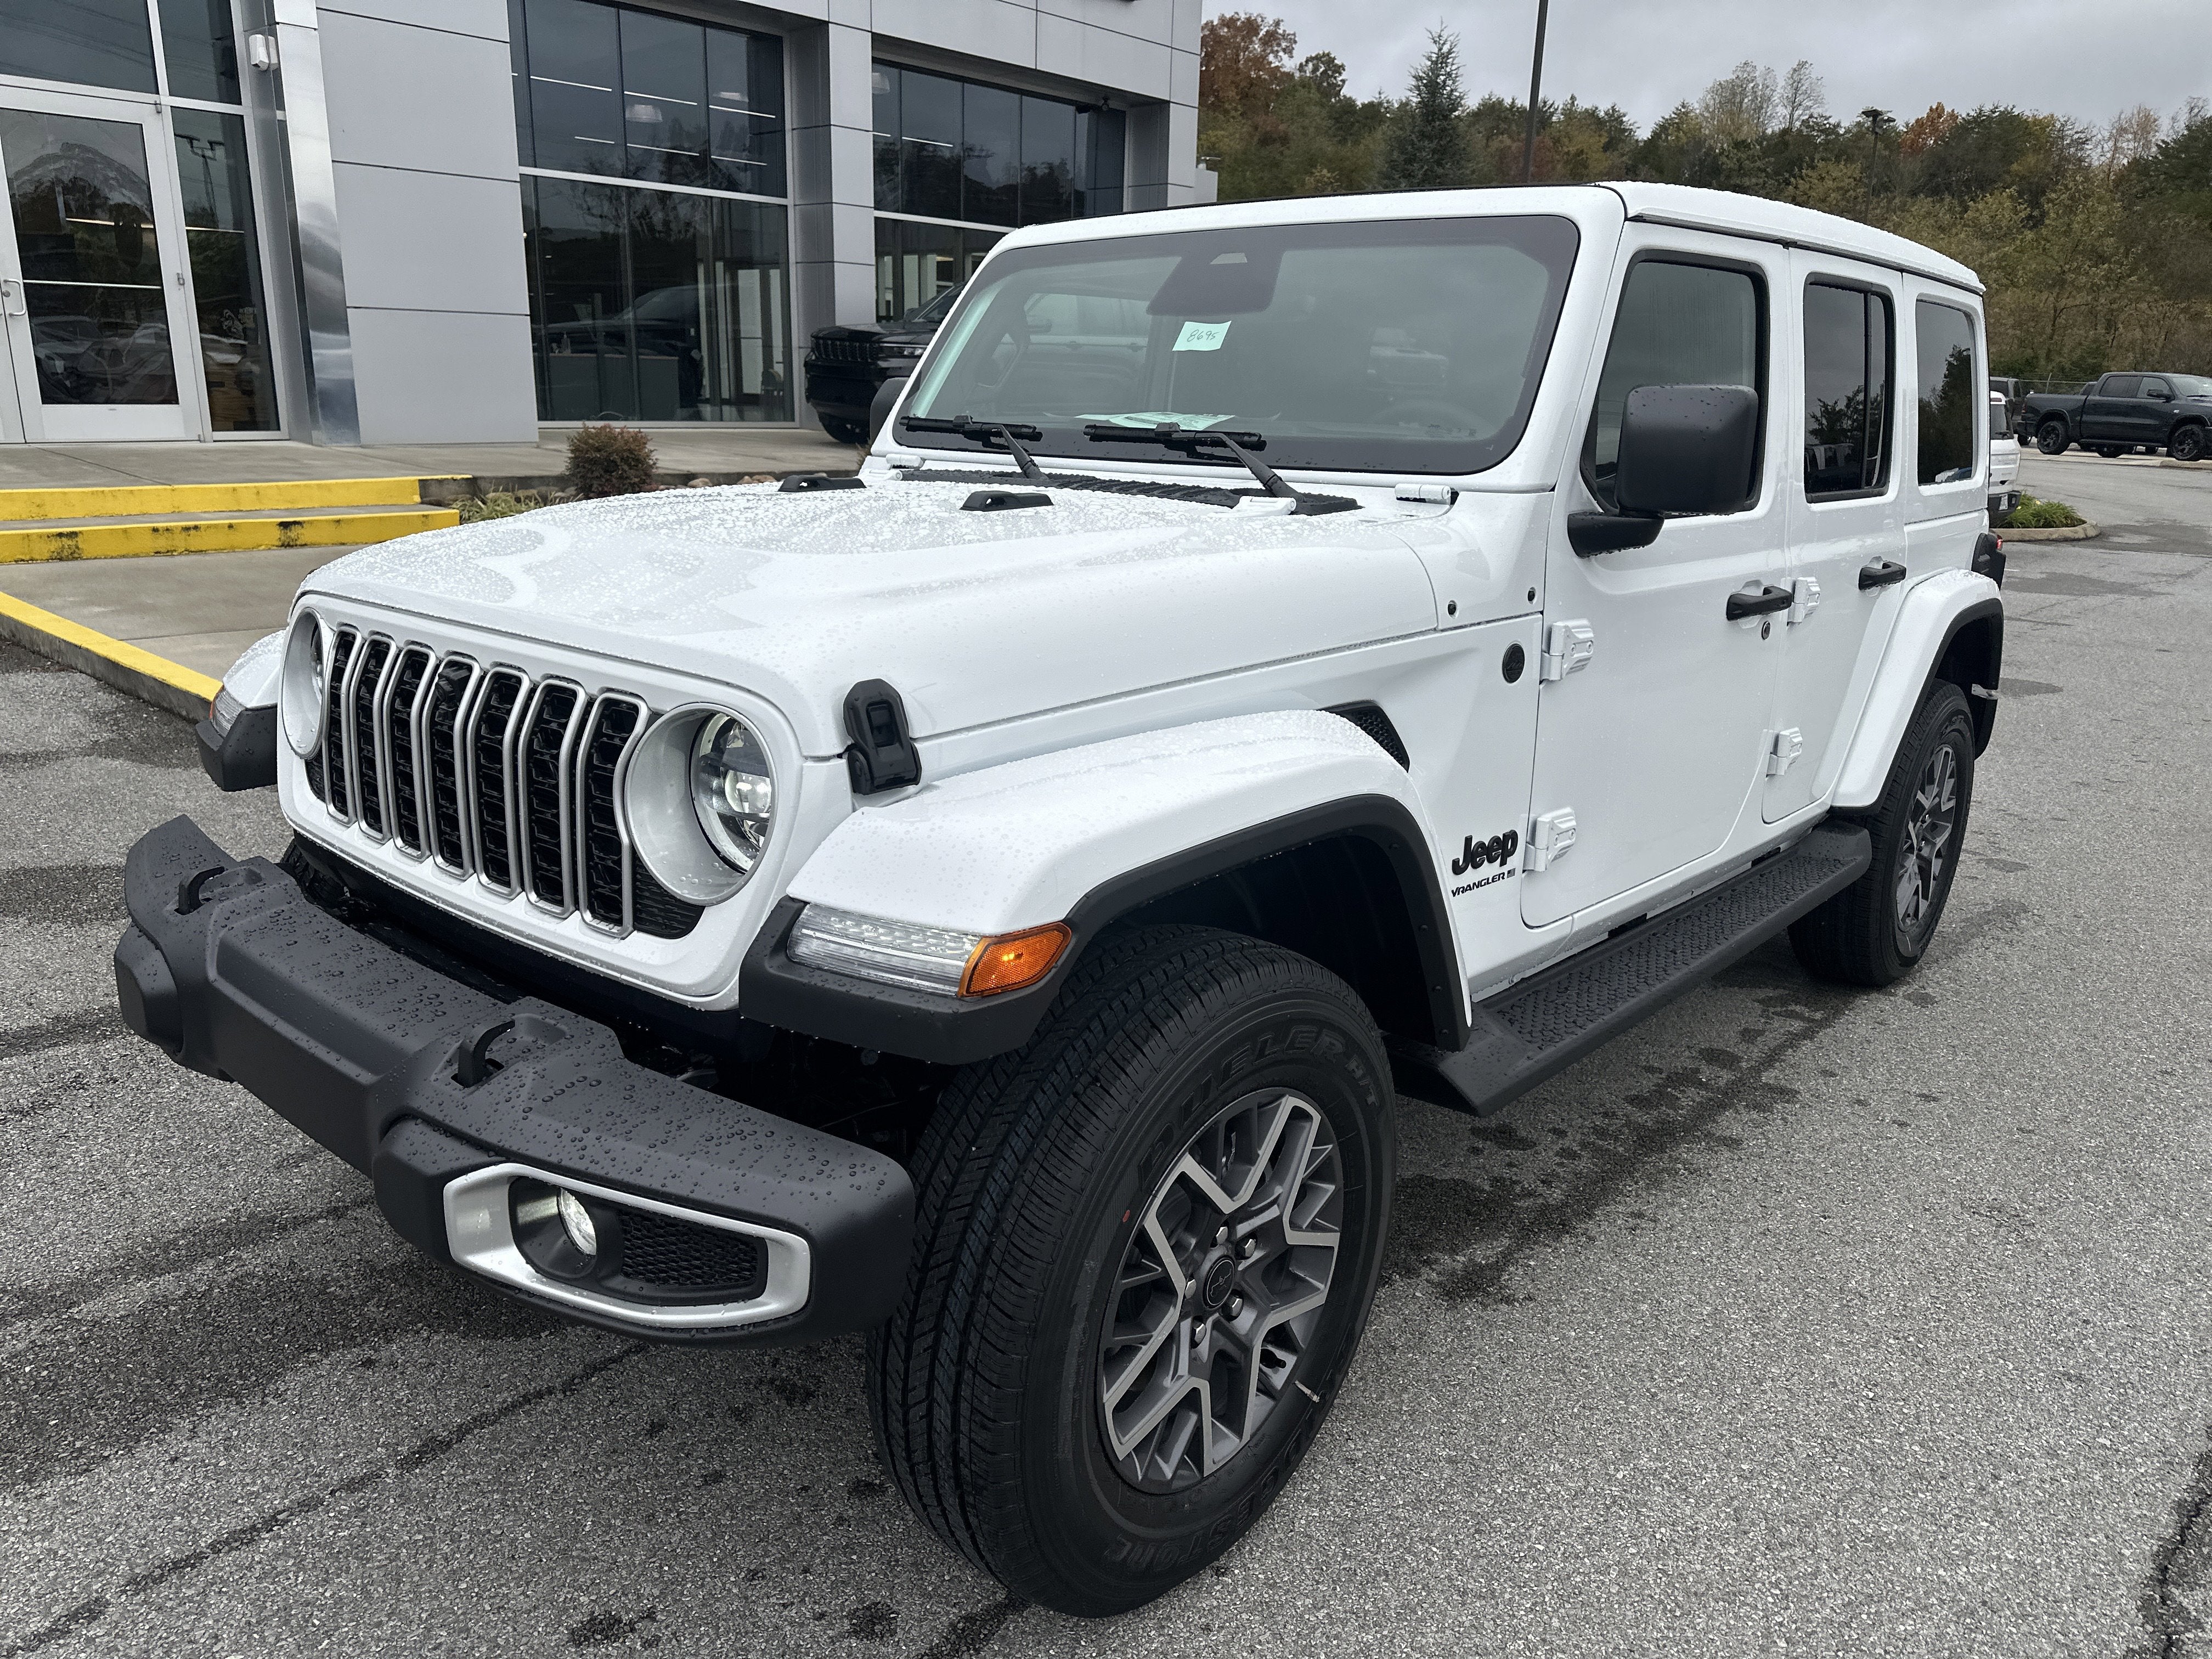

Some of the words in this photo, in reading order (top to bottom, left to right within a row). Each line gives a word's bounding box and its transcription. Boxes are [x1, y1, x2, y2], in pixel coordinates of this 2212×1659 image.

[1187, 329, 1221, 342] 8695
[1452, 829, 1519, 876] Jeep
[1451, 871, 1505, 898] WRANGLER
[1138, 1024, 1346, 1193] DUELER
